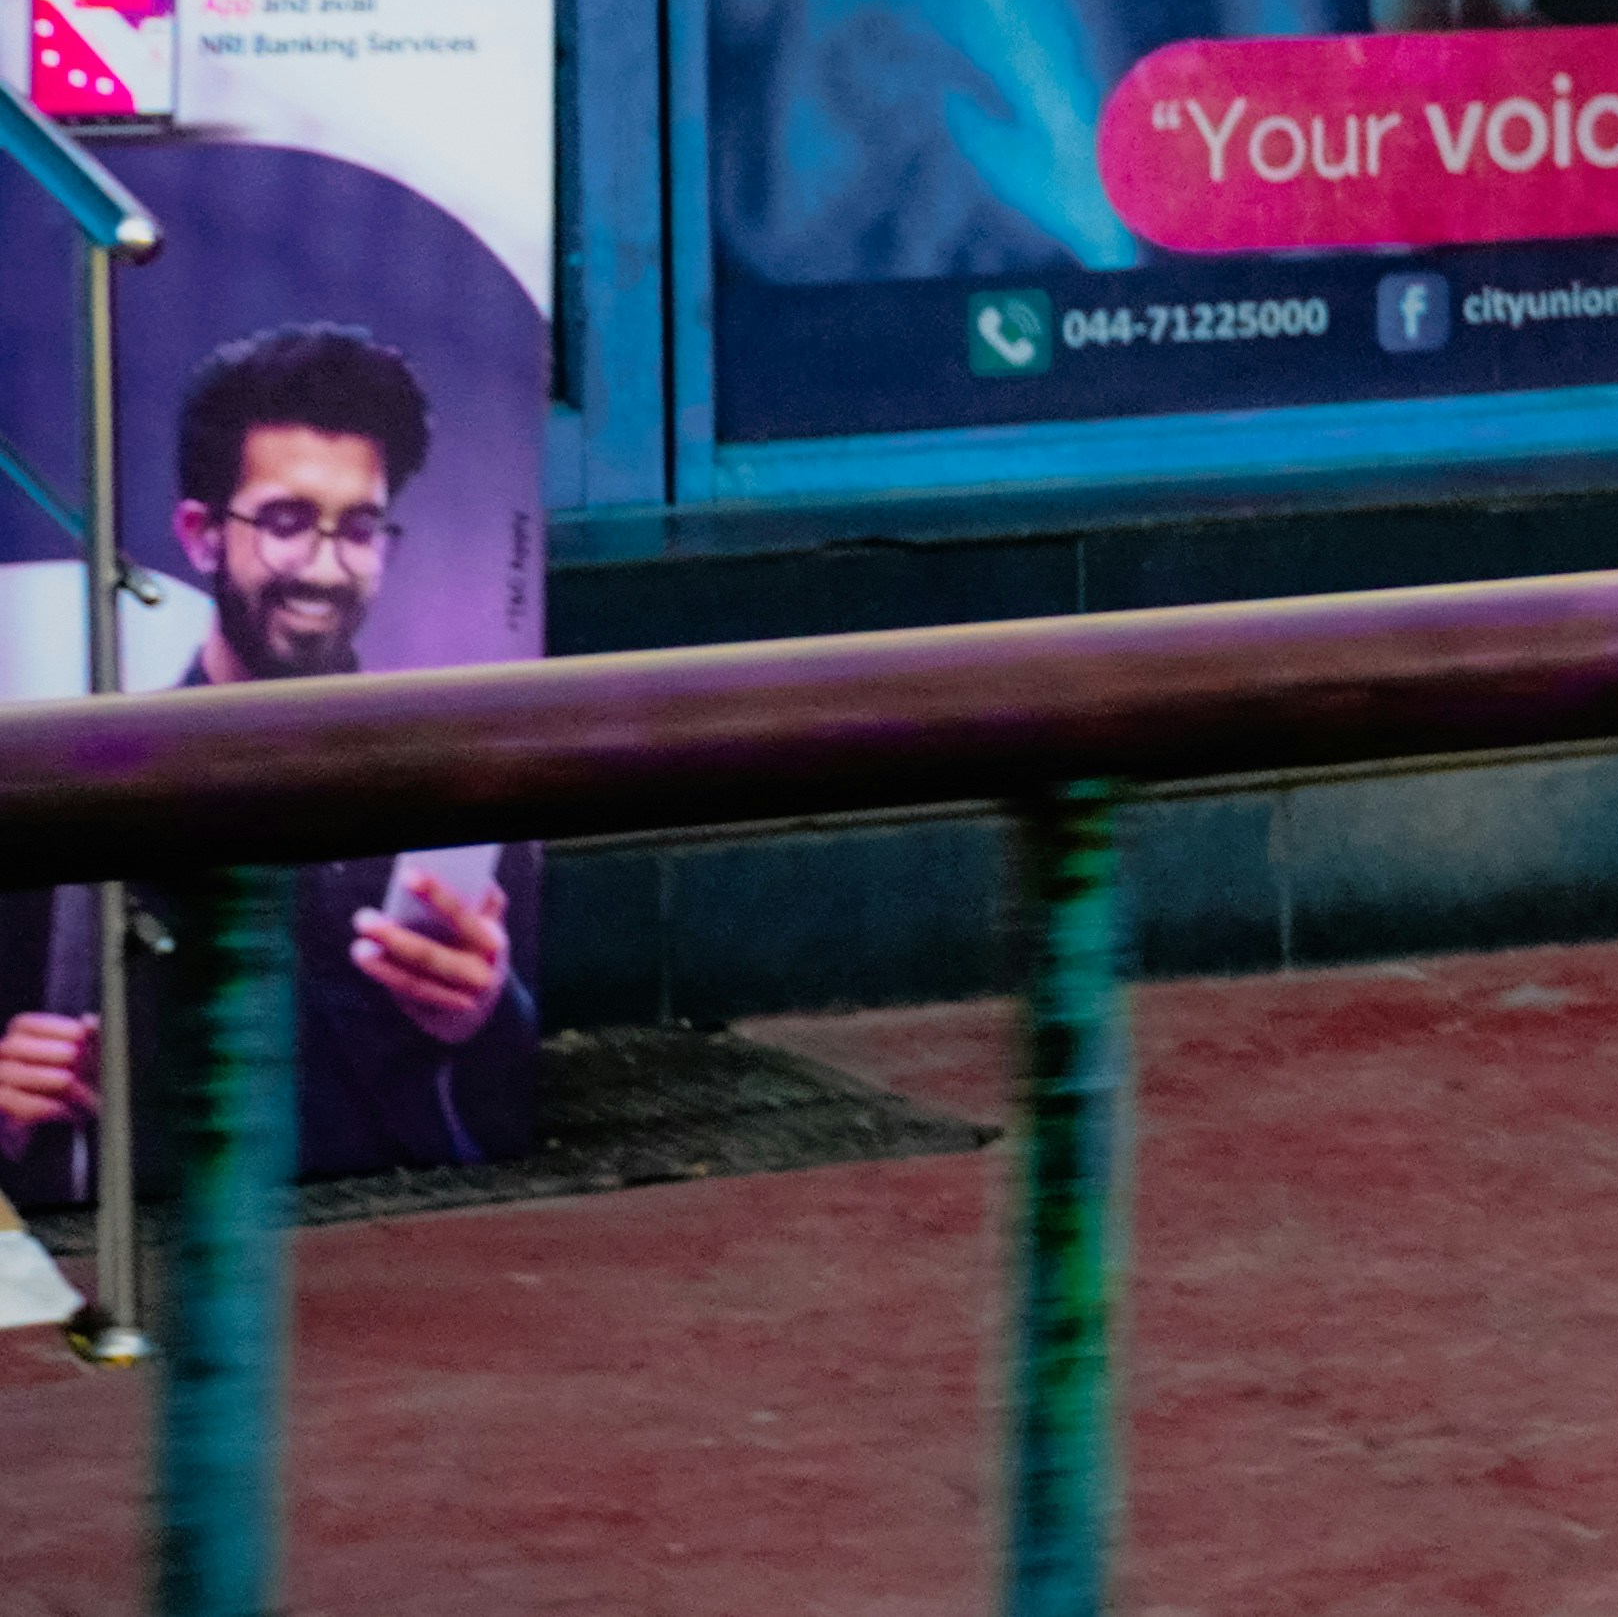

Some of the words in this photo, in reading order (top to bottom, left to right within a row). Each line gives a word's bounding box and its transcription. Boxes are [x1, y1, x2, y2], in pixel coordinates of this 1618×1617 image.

[254, 34, 358, 58] Banking
[1152, 97, 1401, 183] “Your
[1063, 298, 1329, 350] 044-71225000
